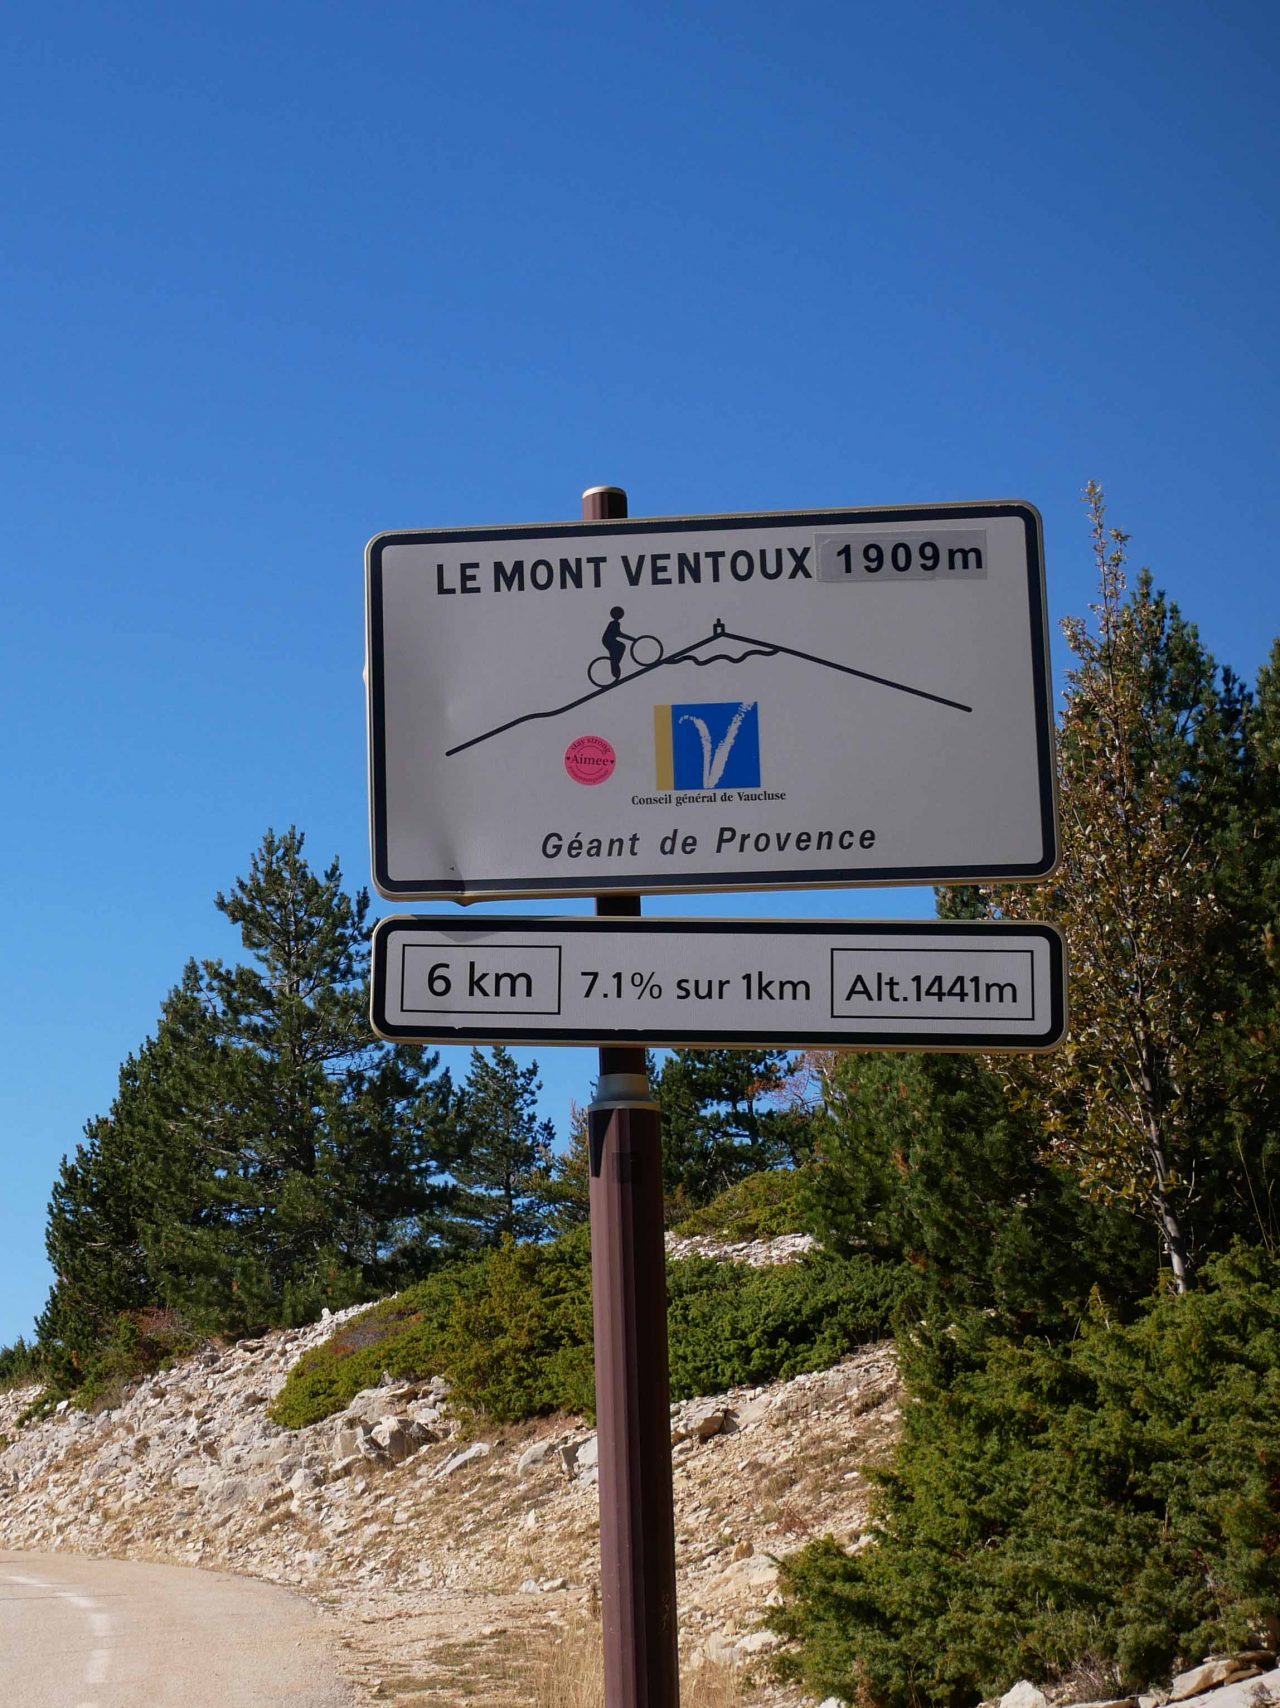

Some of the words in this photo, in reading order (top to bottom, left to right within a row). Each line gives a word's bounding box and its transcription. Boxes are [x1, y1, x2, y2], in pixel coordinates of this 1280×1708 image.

[437, 563, 481, 595] LE
[494, 557, 607, 592] MONT
[621, 547, 812, 586] VENTOUX
[837, 542, 982, 573] 1909m
[571, 754, 609, 766] Aimee
[631, 794, 672, 805] Conseil
[675, 792, 717, 807] général
[720, 792, 734, 803] de
[737, 790, 786, 802] Vaucluse
[542, 832, 639, 858] Géant
[660, 829, 697, 855] de
[716, 827, 875, 853] Provence
[428, 963, 451, 996] 6
[469, 961, 532, 997] km
[581, 972, 662, 999] 7.1%
[677, 979, 730, 999] sur
[742, 971, 810, 1000] 1km
[845, 972, 1017, 1003] Alt.1441m
